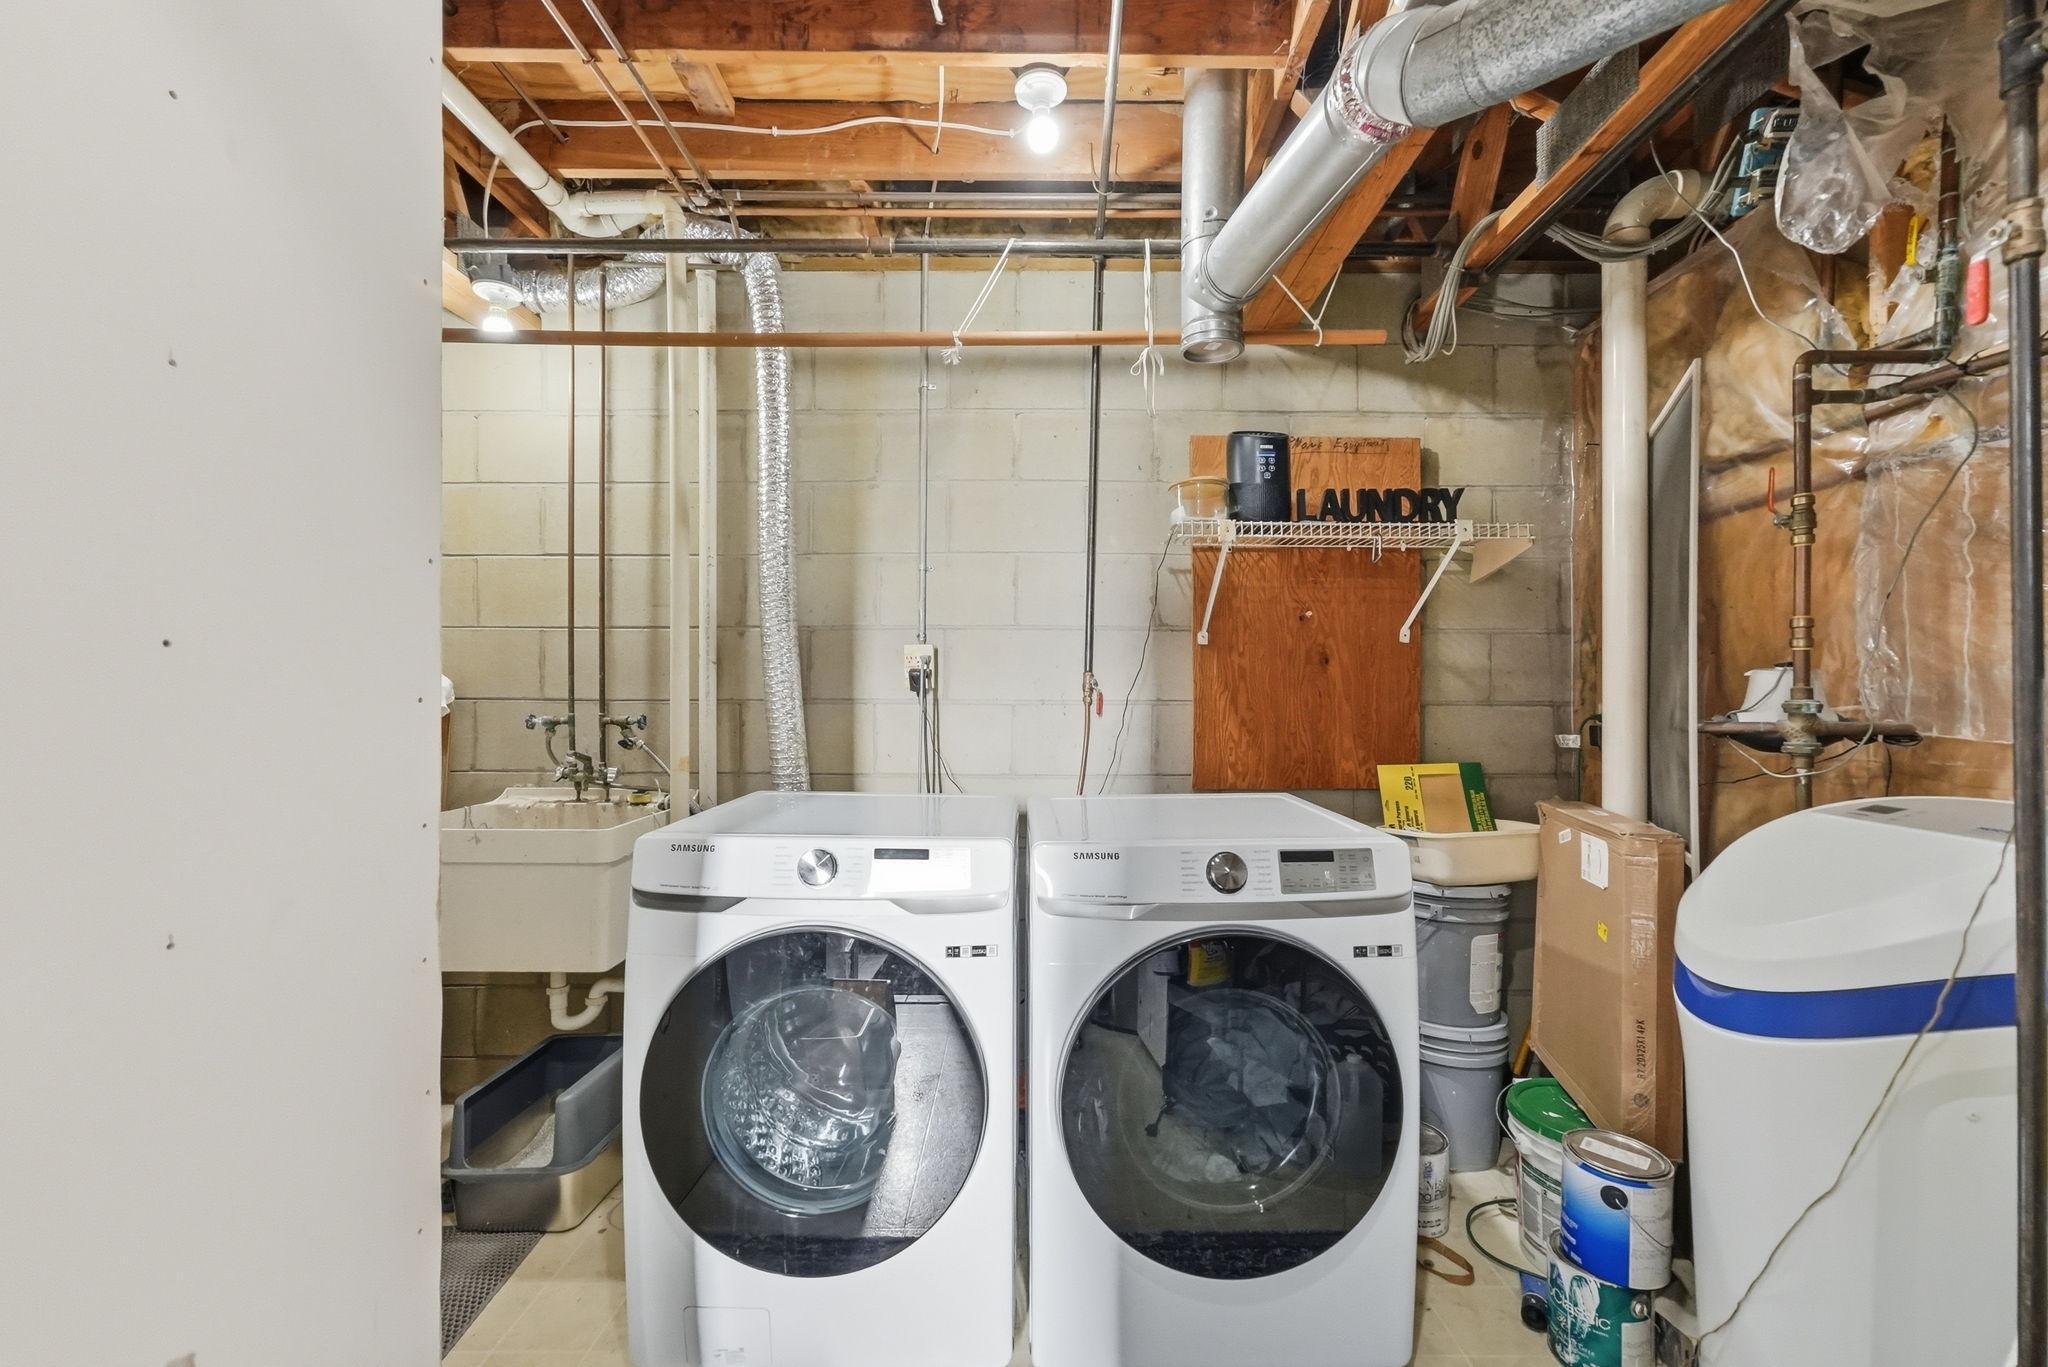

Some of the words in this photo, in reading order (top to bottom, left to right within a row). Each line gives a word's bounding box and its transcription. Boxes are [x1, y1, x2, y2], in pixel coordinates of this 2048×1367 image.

[1297, 488, 1465, 523] LAUNDRY
[1404, 776, 1413, 790] 220
[670, 843, 716, 853] SAMSUNG
[1073, 852, 1120, 861] SAMSUNG
